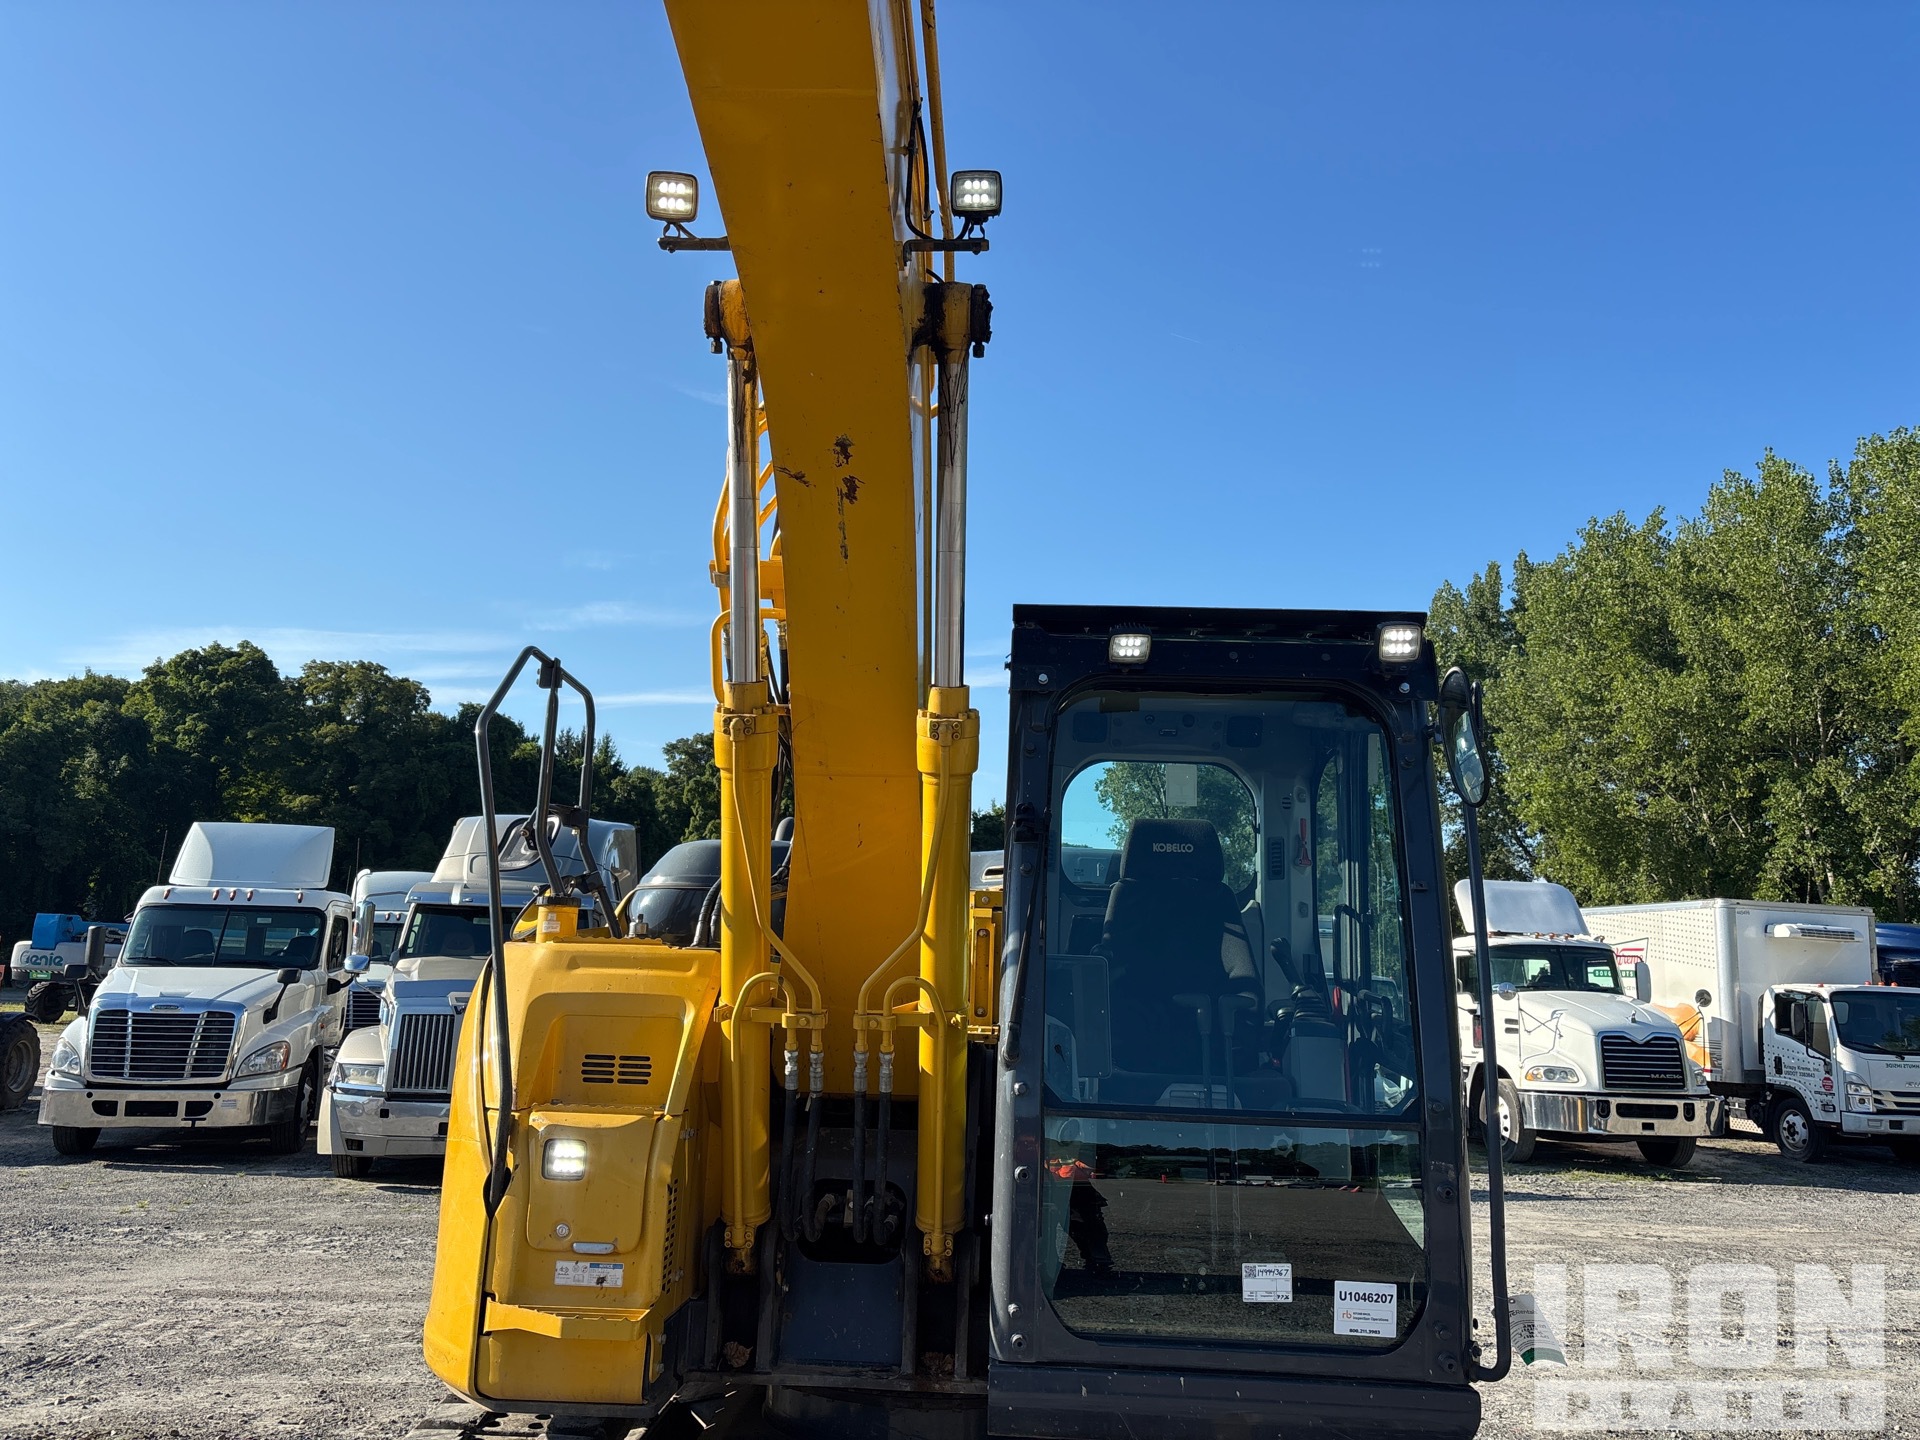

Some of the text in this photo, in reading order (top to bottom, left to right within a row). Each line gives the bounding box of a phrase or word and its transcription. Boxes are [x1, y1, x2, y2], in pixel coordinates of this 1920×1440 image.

[1152, 842, 1194, 853] KOBELCO
[20, 950, 64, 967] Genie
[1339, 1291, 1394, 1304] U1046207
[1342, 1310, 1352, 1319] rb
